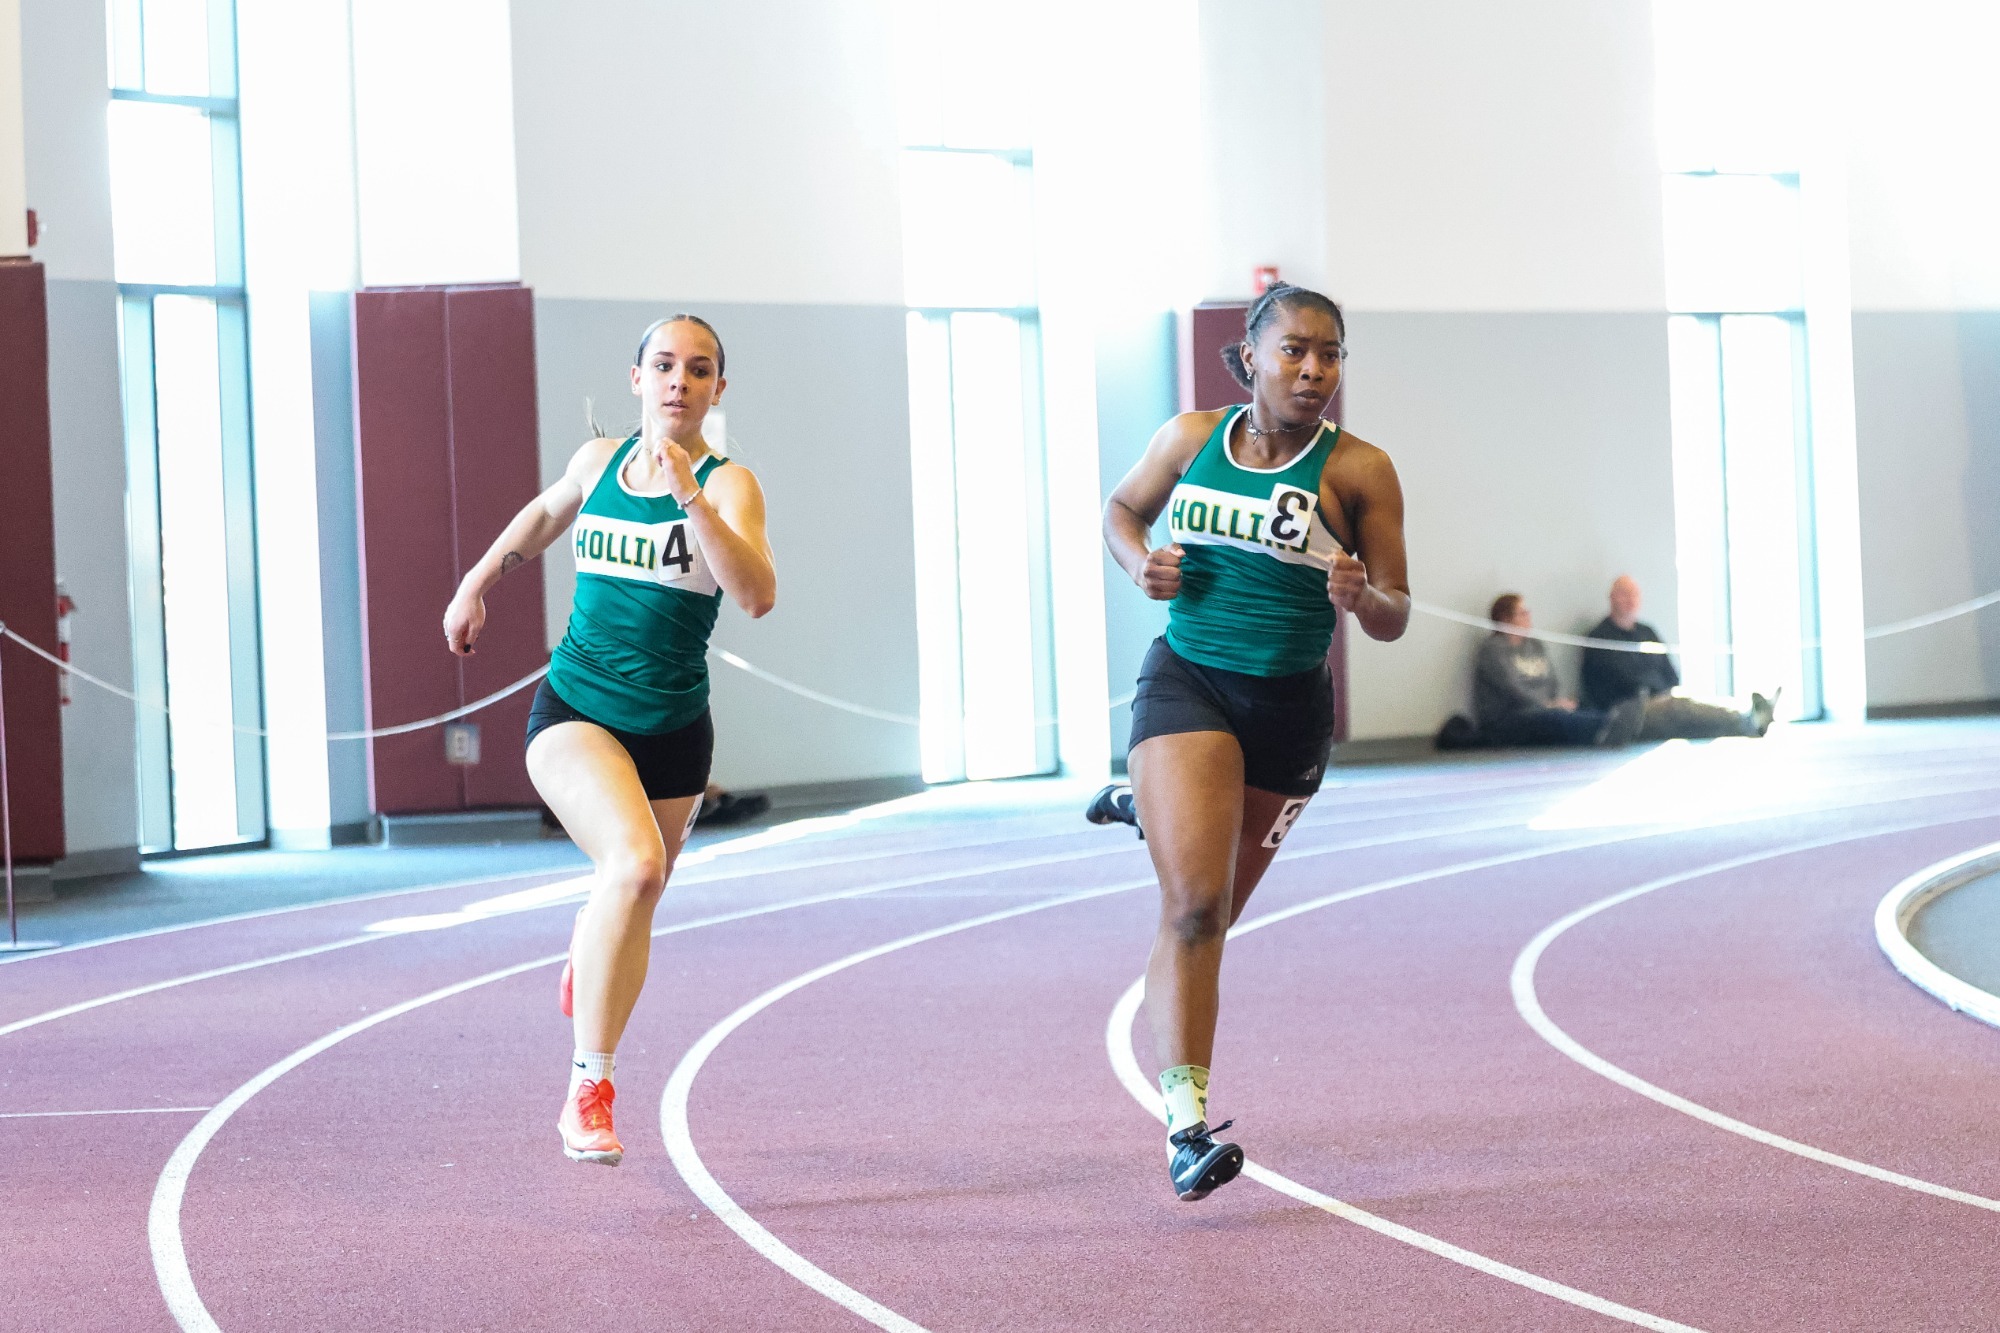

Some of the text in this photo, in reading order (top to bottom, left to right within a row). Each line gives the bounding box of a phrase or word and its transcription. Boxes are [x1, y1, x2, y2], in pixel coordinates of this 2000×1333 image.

[661, 523, 694, 574] 4
[1171, 498, 1311, 553] HOLLI
[1271, 802, 1304, 845] 3
